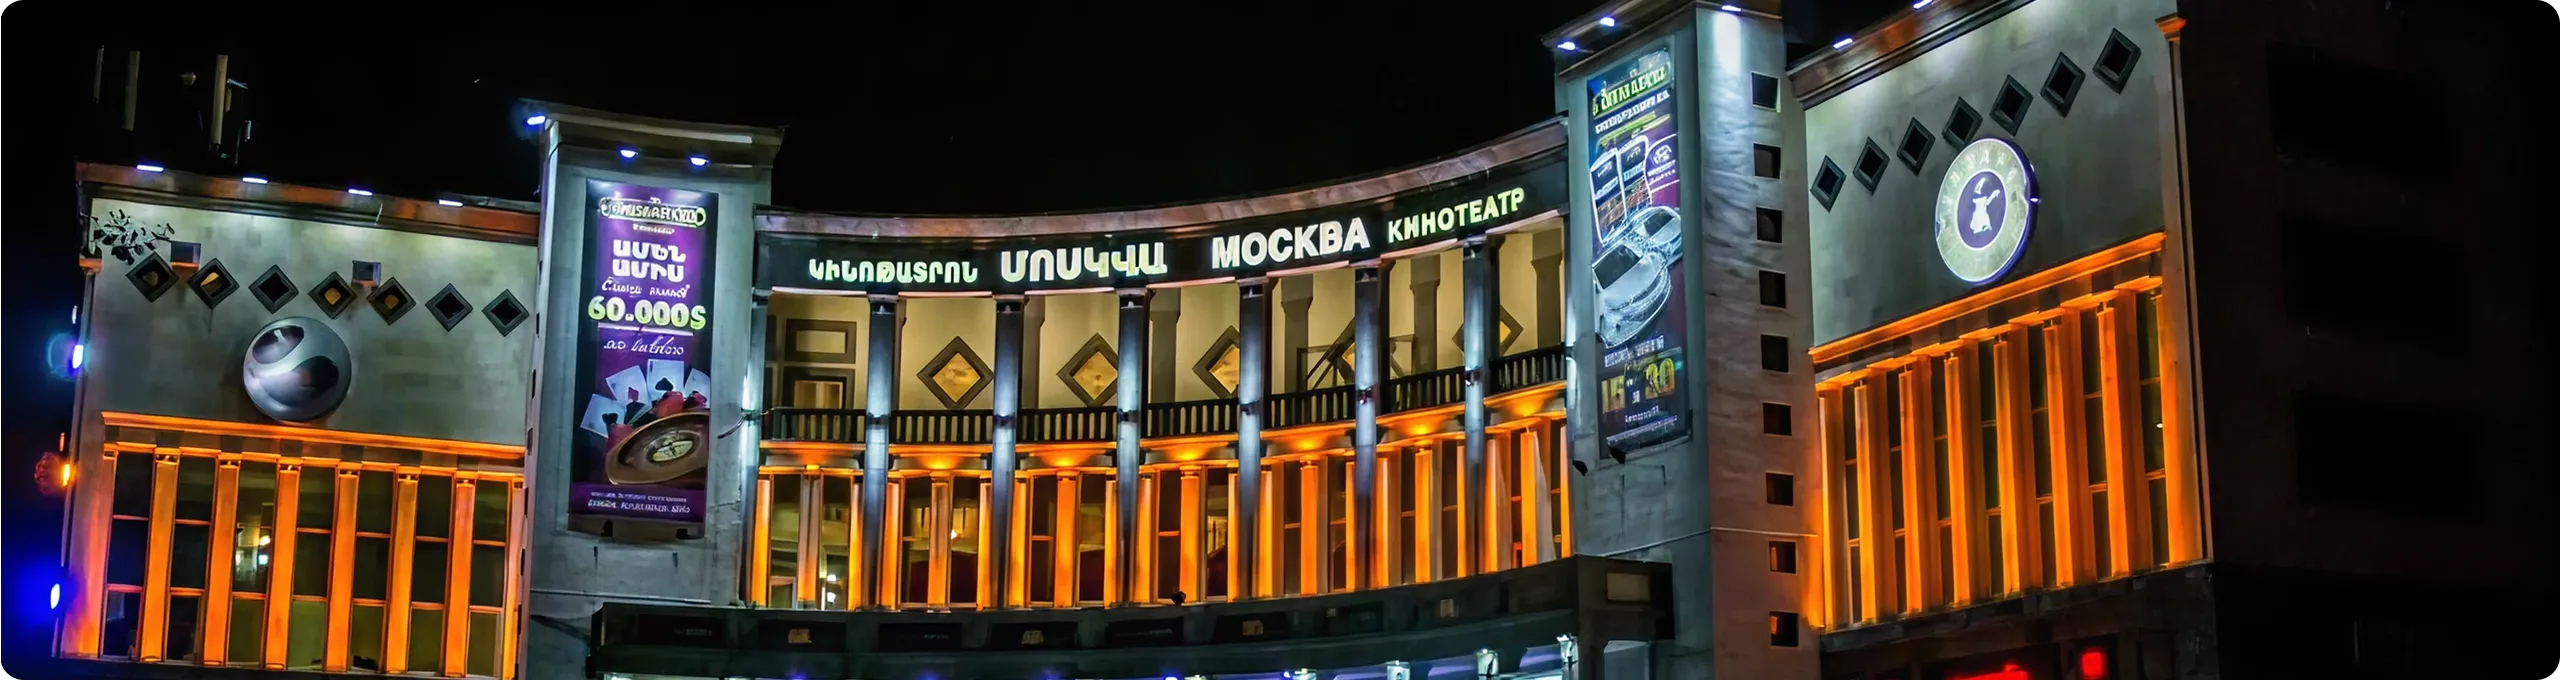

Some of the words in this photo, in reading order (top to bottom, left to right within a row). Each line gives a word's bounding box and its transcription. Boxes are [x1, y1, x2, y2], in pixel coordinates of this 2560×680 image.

[1211, 216, 1371, 270] МОСКВА
[1387, 187, 1526, 244] КИНОТЕАТР
[808, 258, 979, 284] ԿԻՆՈԹԱՏՐՈՆ
[1000, 241, 1168, 283] ՄՈՍԿՎԱ
